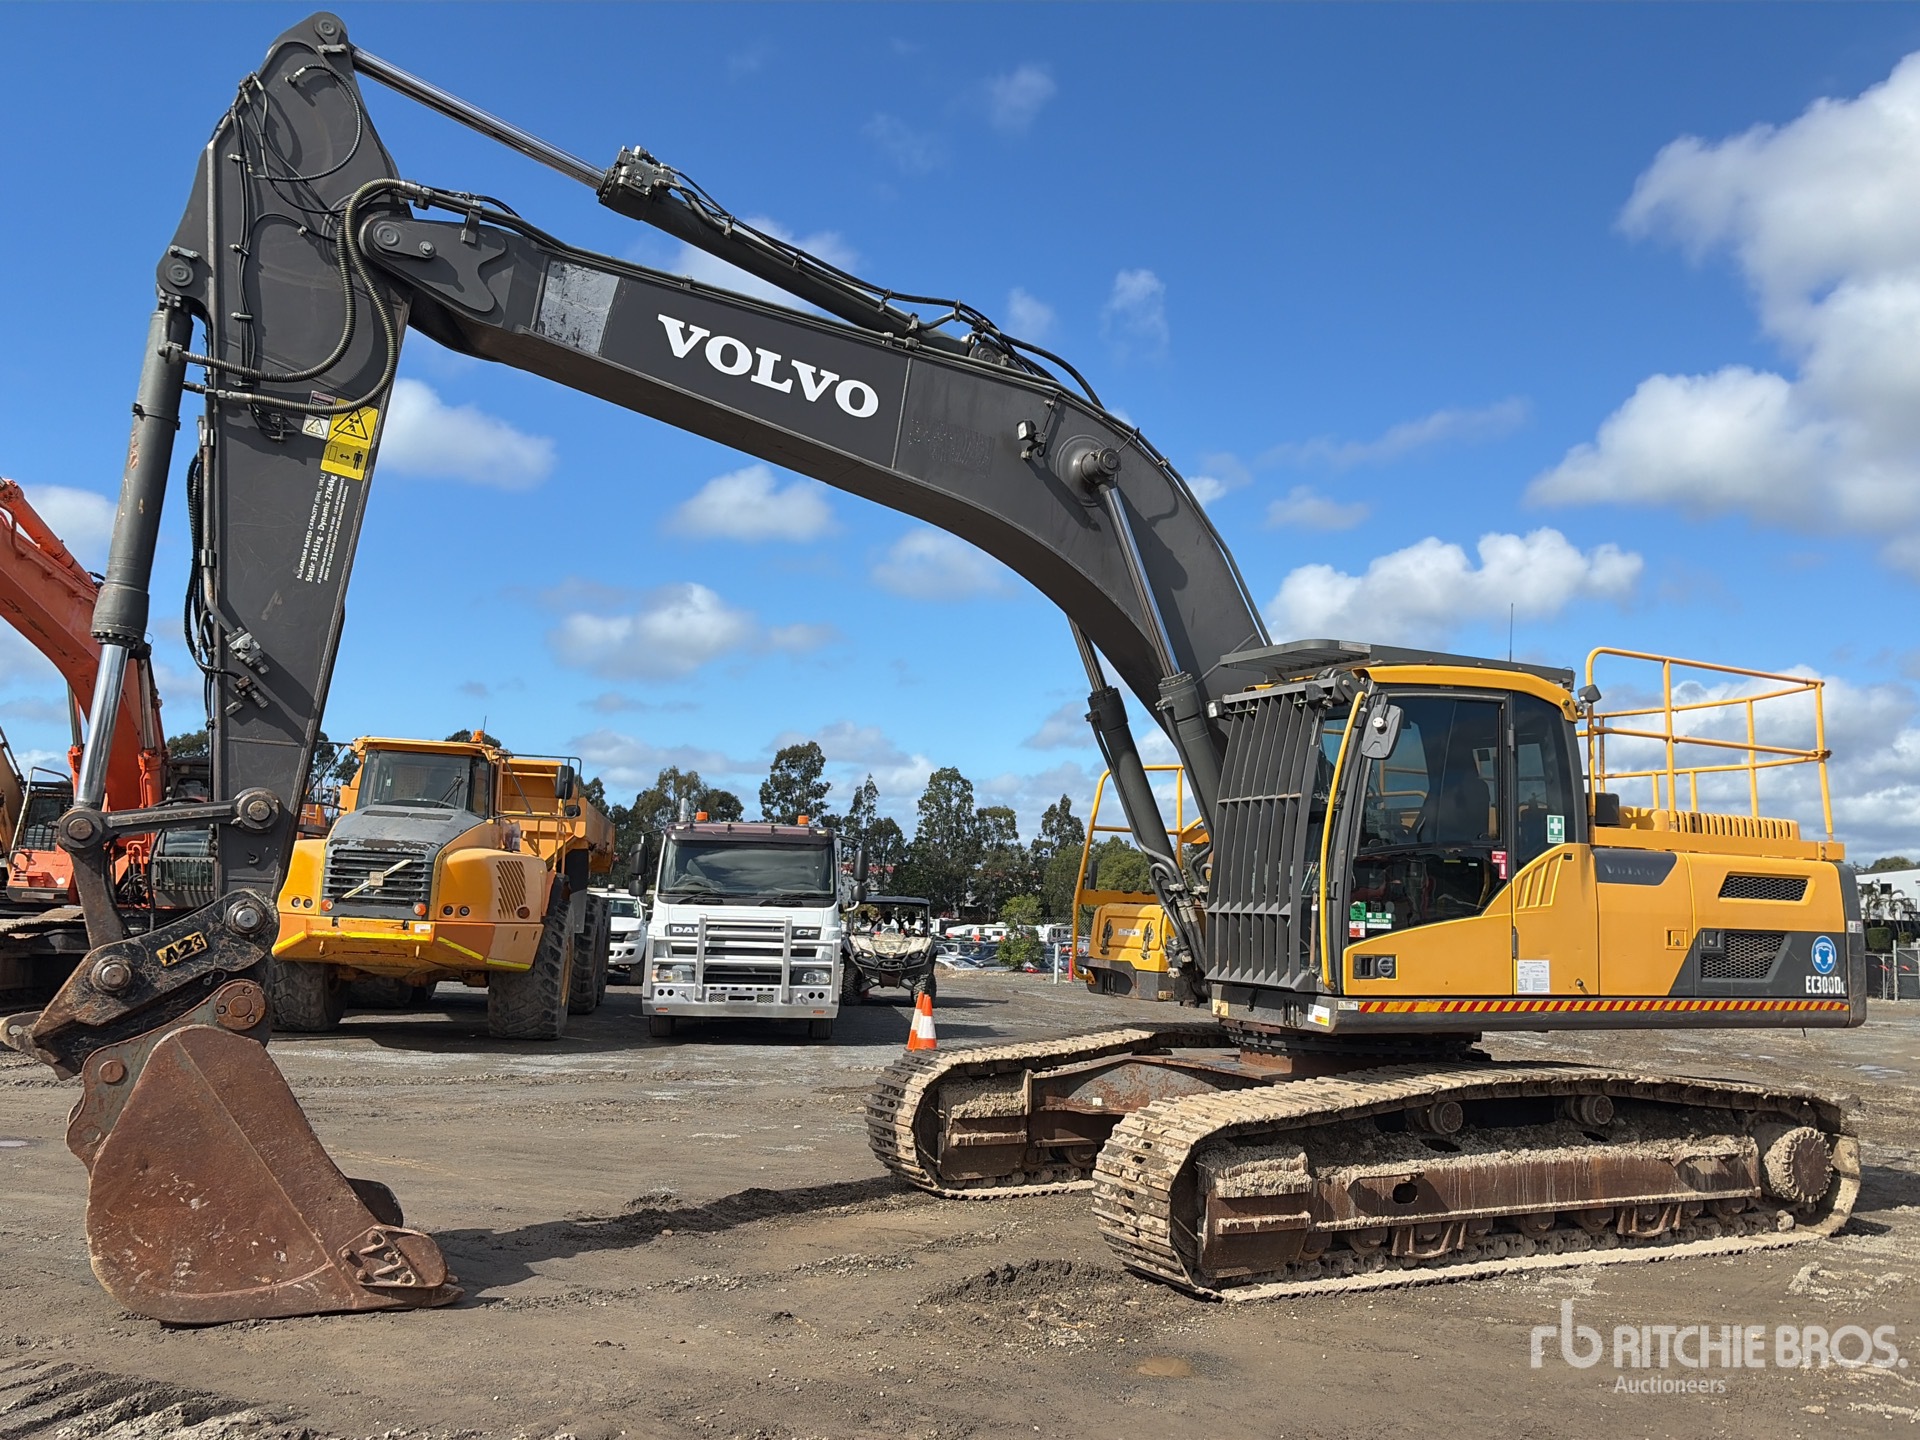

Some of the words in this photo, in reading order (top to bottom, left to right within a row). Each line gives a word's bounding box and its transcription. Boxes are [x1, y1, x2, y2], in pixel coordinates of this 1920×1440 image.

[657, 313, 880, 419] VOLVO
[305, 562, 315, 582] Static
[310, 536, 324, 561] 3141kg
[317, 501, 330, 531] Dynamic
[325, 475, 338, 500] 2764kg
[308, 504, 319, 530] CAPACITY
[304, 530, 313, 548] RATED
[165, 934, 205, 964] A23
